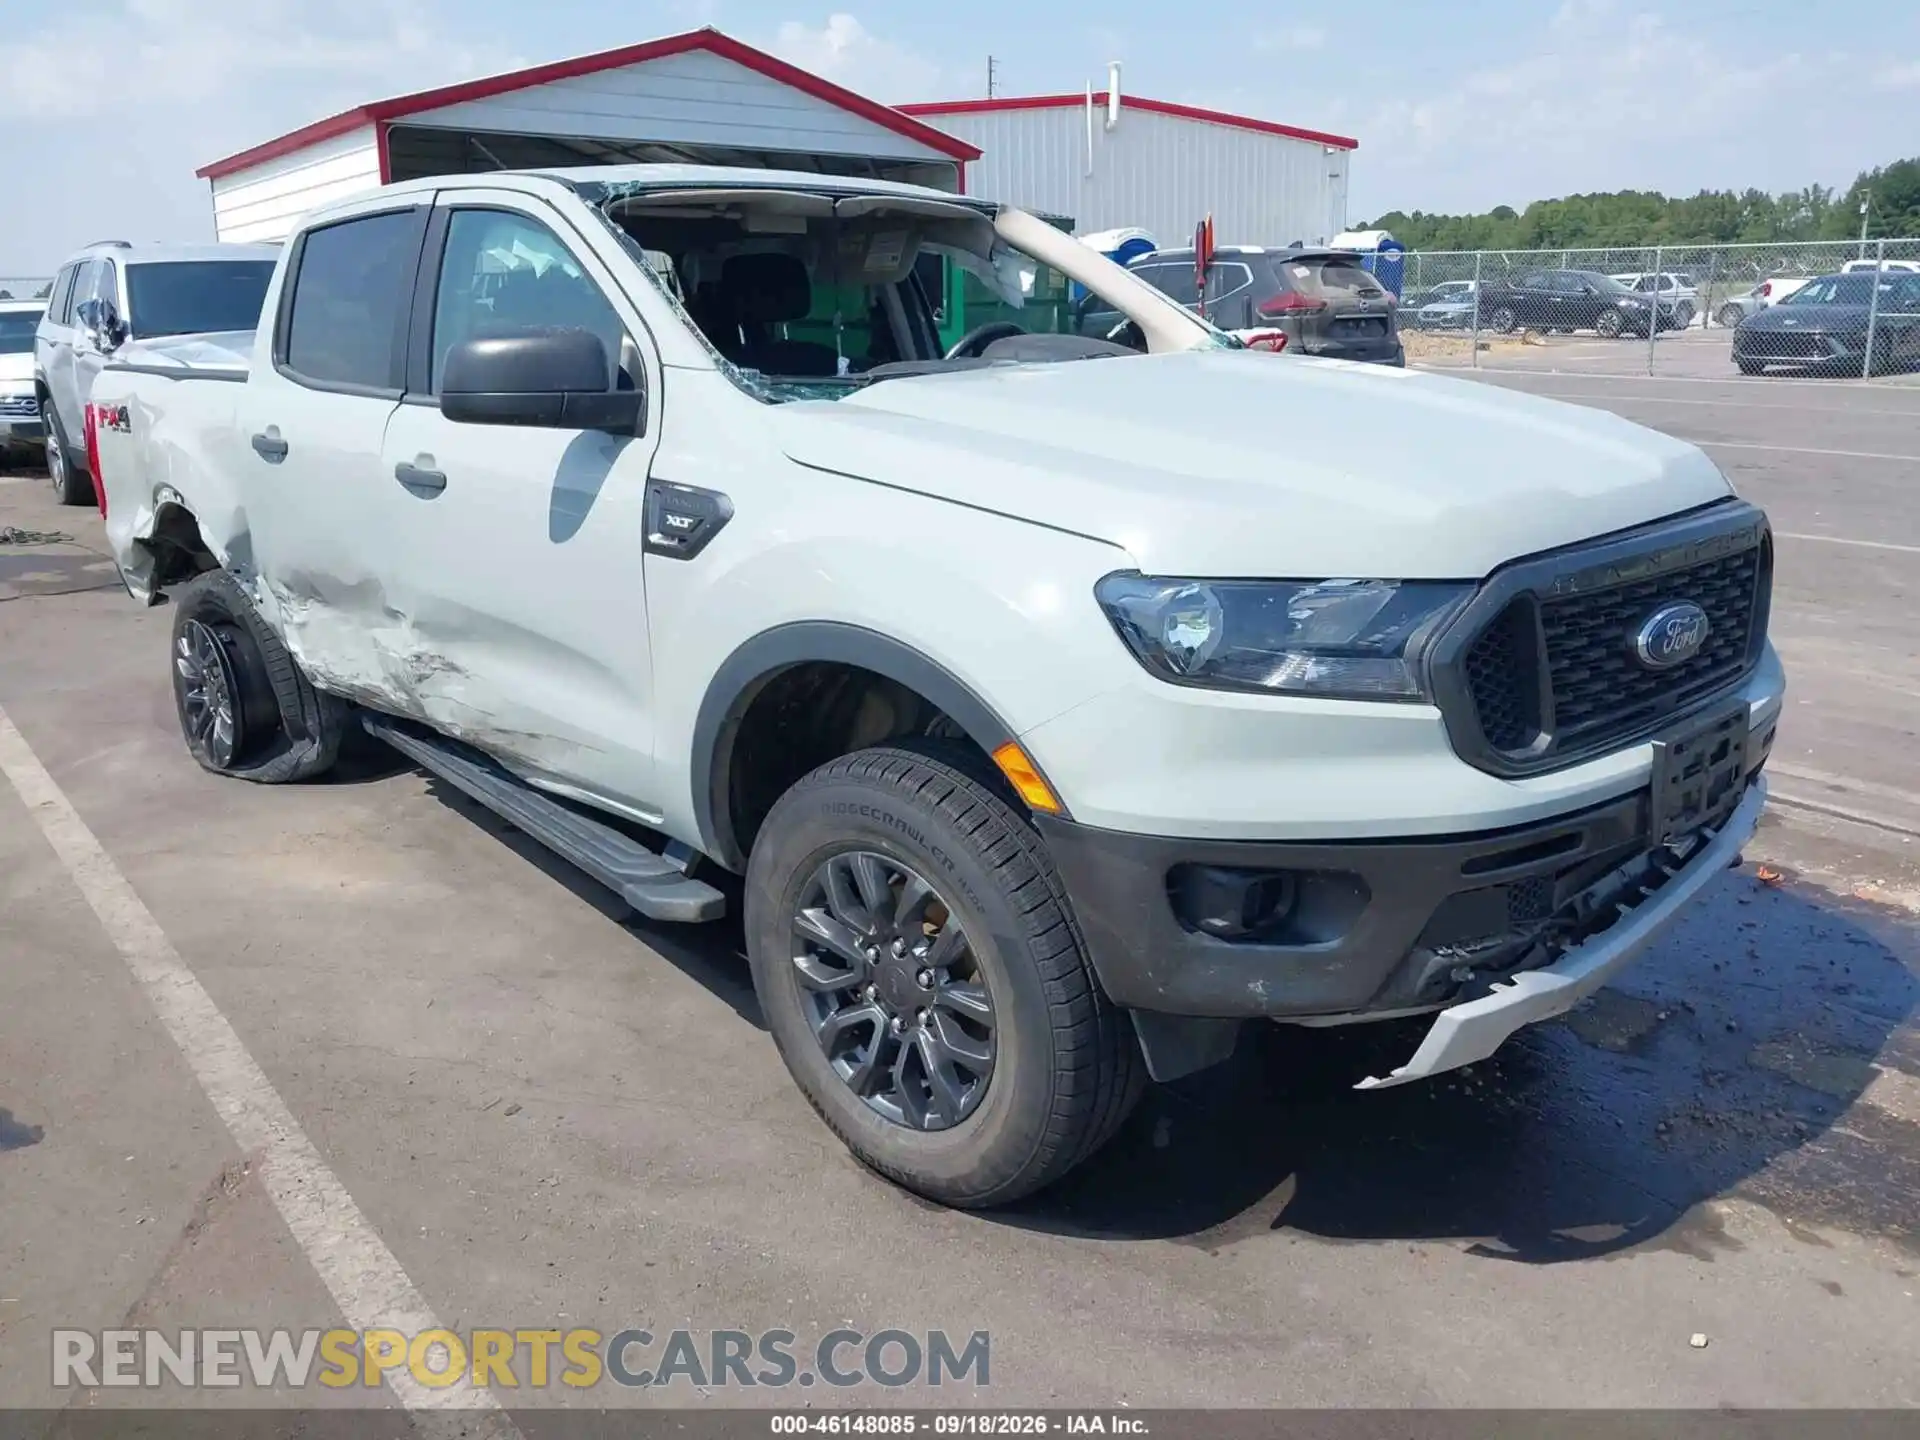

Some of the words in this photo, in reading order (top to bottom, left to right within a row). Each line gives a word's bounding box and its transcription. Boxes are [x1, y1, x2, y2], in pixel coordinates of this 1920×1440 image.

[98, 405, 130, 428] FX4
[665, 514, 693, 529] XLT
[1663, 616, 1700, 654] Ford
[821, 801, 955, 873] RIDGECRAWLER
